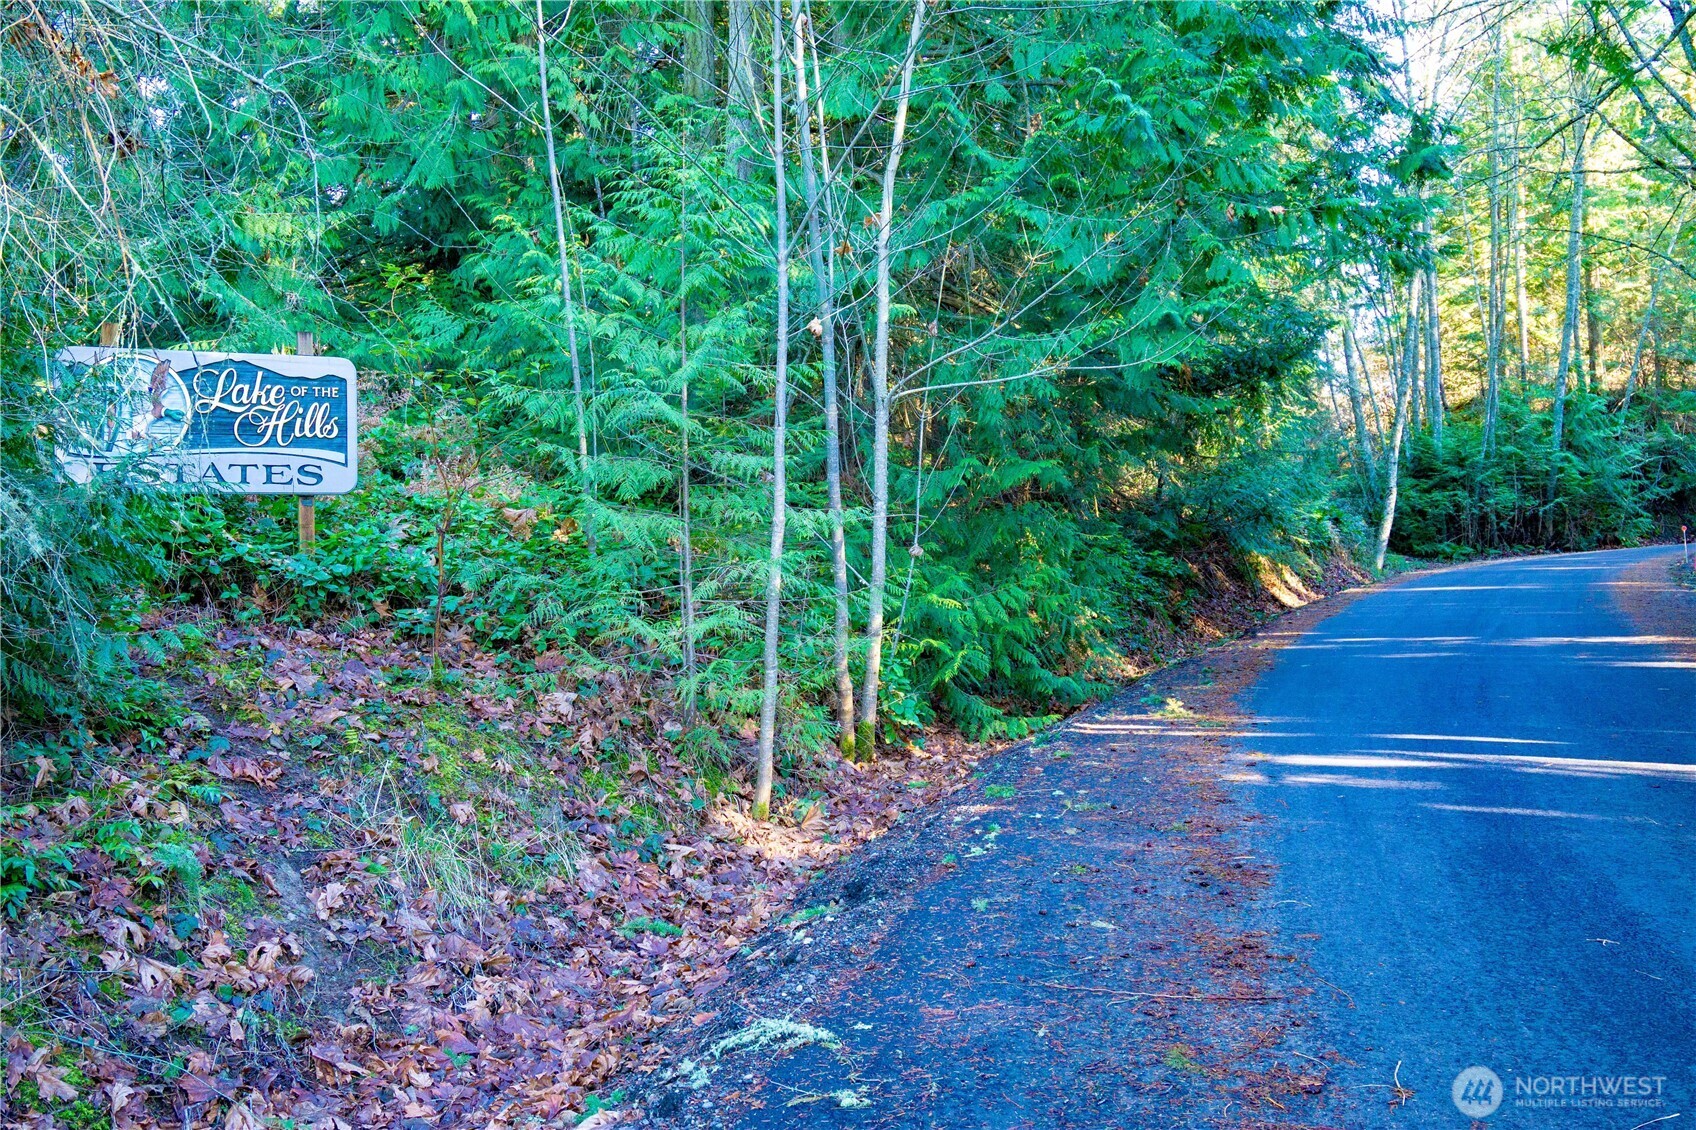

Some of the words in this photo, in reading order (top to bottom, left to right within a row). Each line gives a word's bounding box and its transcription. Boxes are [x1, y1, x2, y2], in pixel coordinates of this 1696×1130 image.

[193, 367, 286, 413] Lake
[291, 386, 308, 398] OF
[313, 386, 340, 398] THE
[234, 401, 339, 447] Hills
[93, 461, 323, 486] TATES
